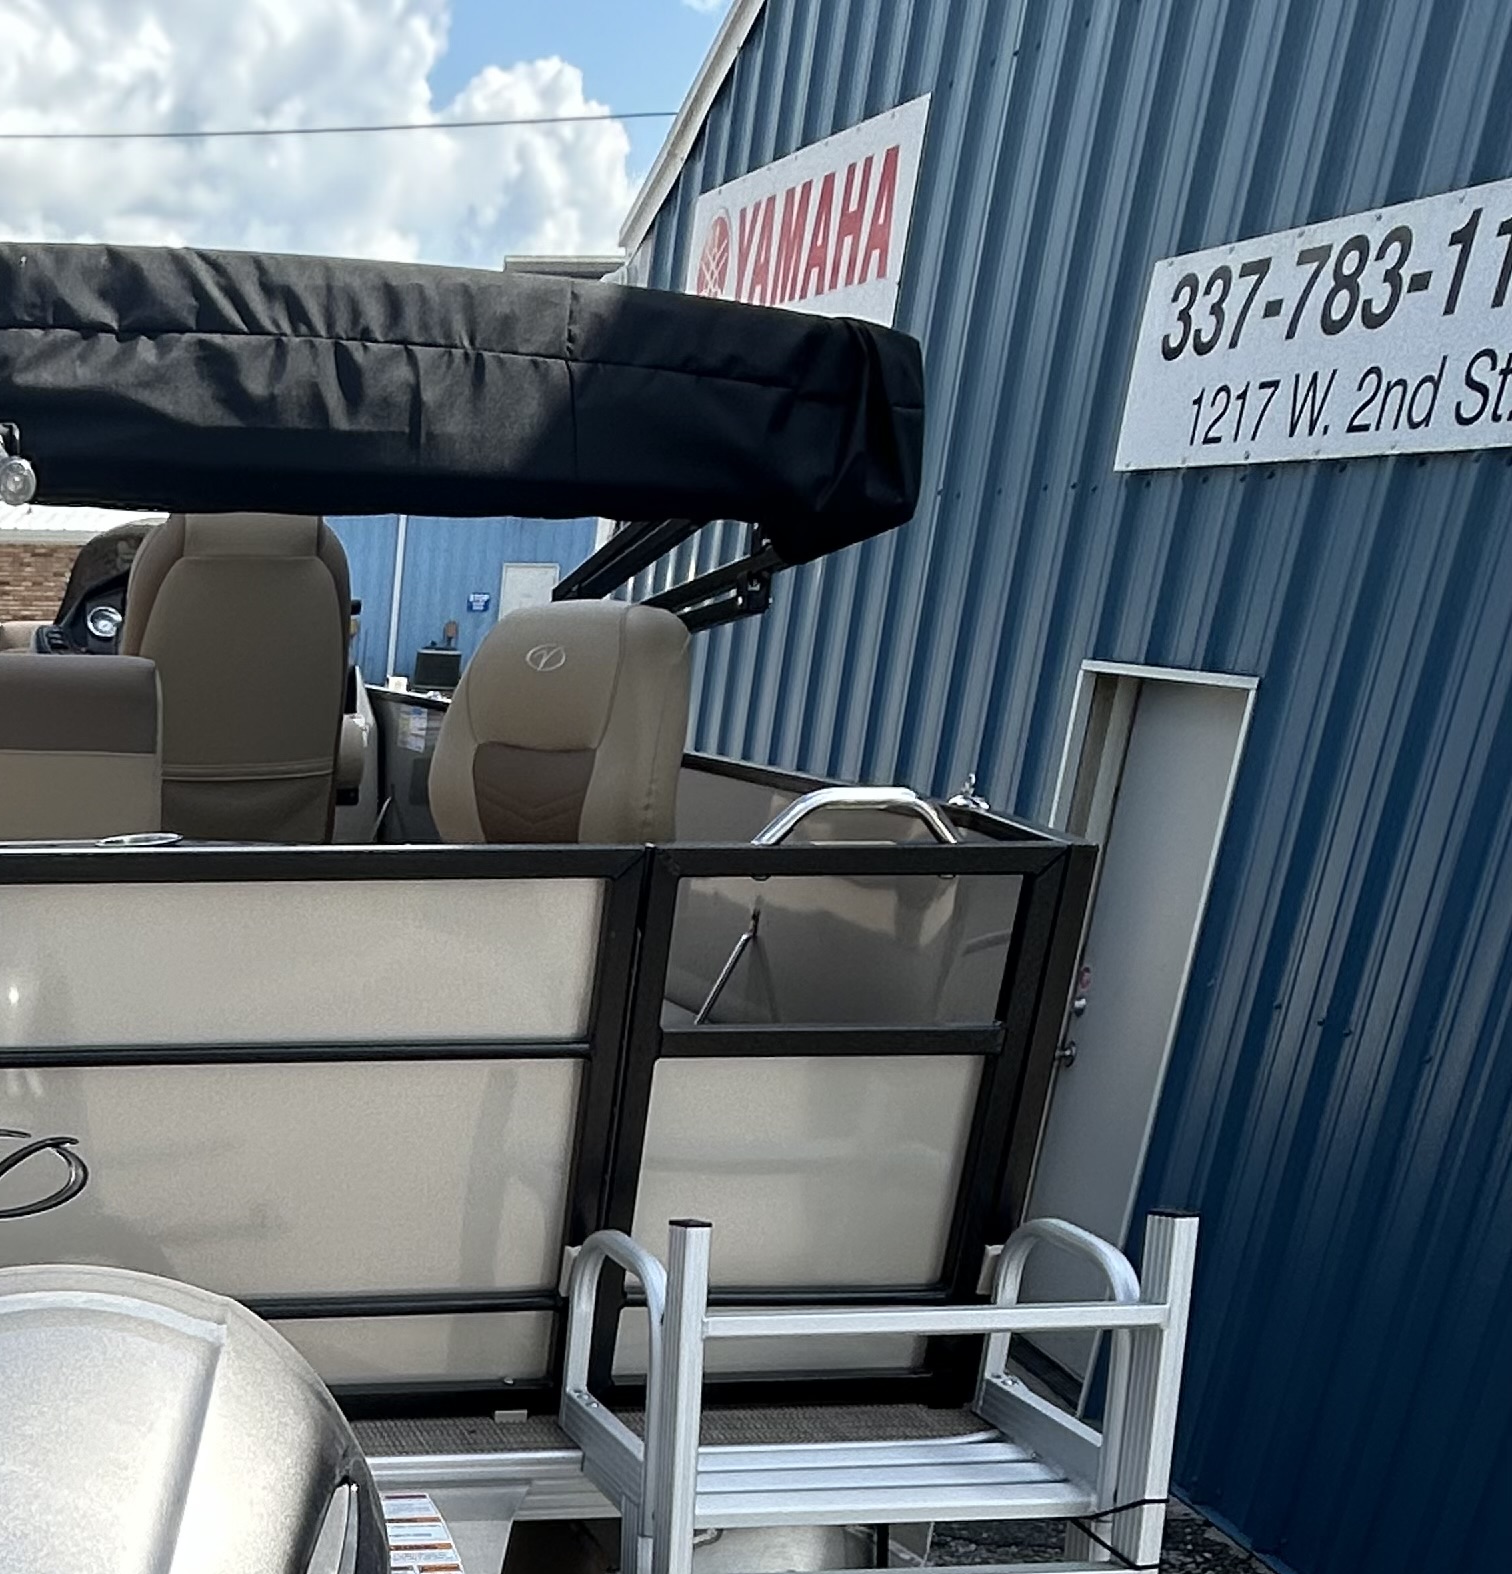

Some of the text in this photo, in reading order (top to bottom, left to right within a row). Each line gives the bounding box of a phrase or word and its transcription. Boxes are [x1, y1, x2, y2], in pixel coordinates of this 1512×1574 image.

[735, 145, 900, 306] YAMAHA
[1189, 379, 1281, 447] 1217
[1288, 369, 1337, 438] W.
[1346, 355, 1448, 434] 2nd
